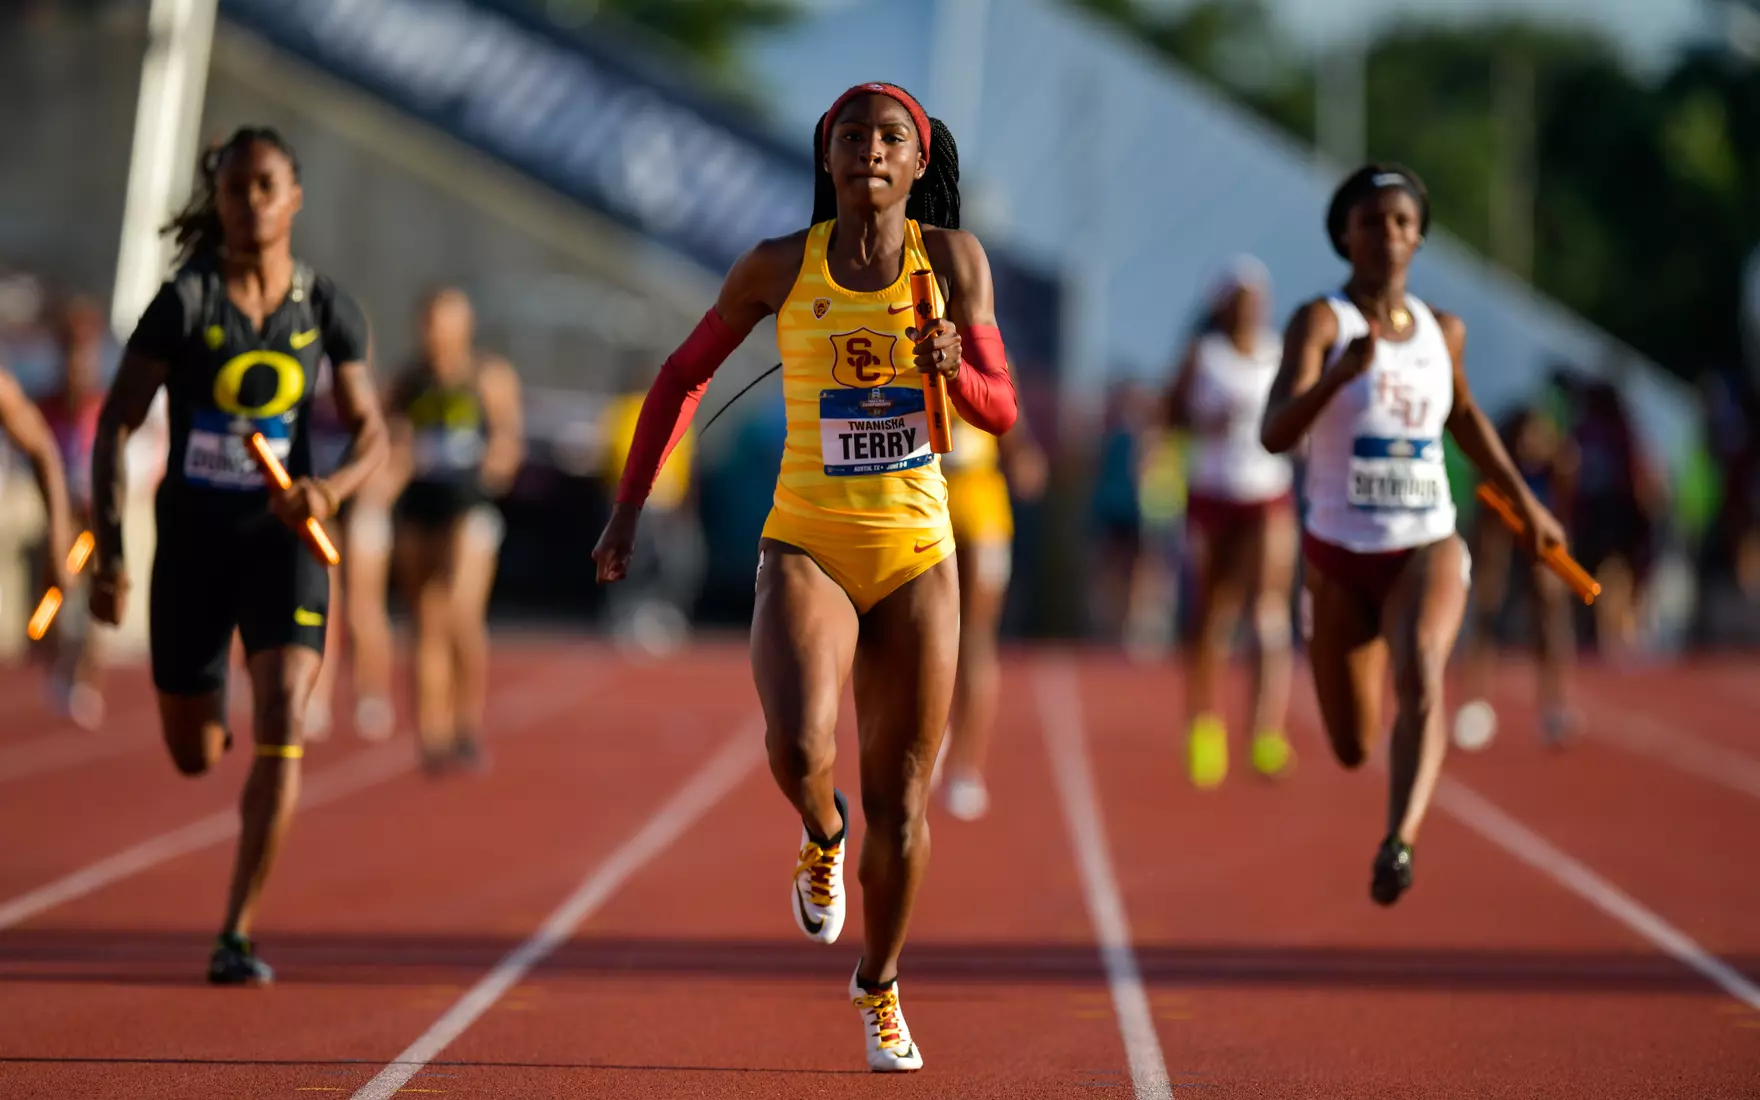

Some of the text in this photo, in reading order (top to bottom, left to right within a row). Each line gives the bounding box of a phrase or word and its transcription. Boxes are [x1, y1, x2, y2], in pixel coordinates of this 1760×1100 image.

[212, 349, 305, 418] O
[848, 418, 905, 431] TWANISHA
[838, 428, 916, 461] TERRY
